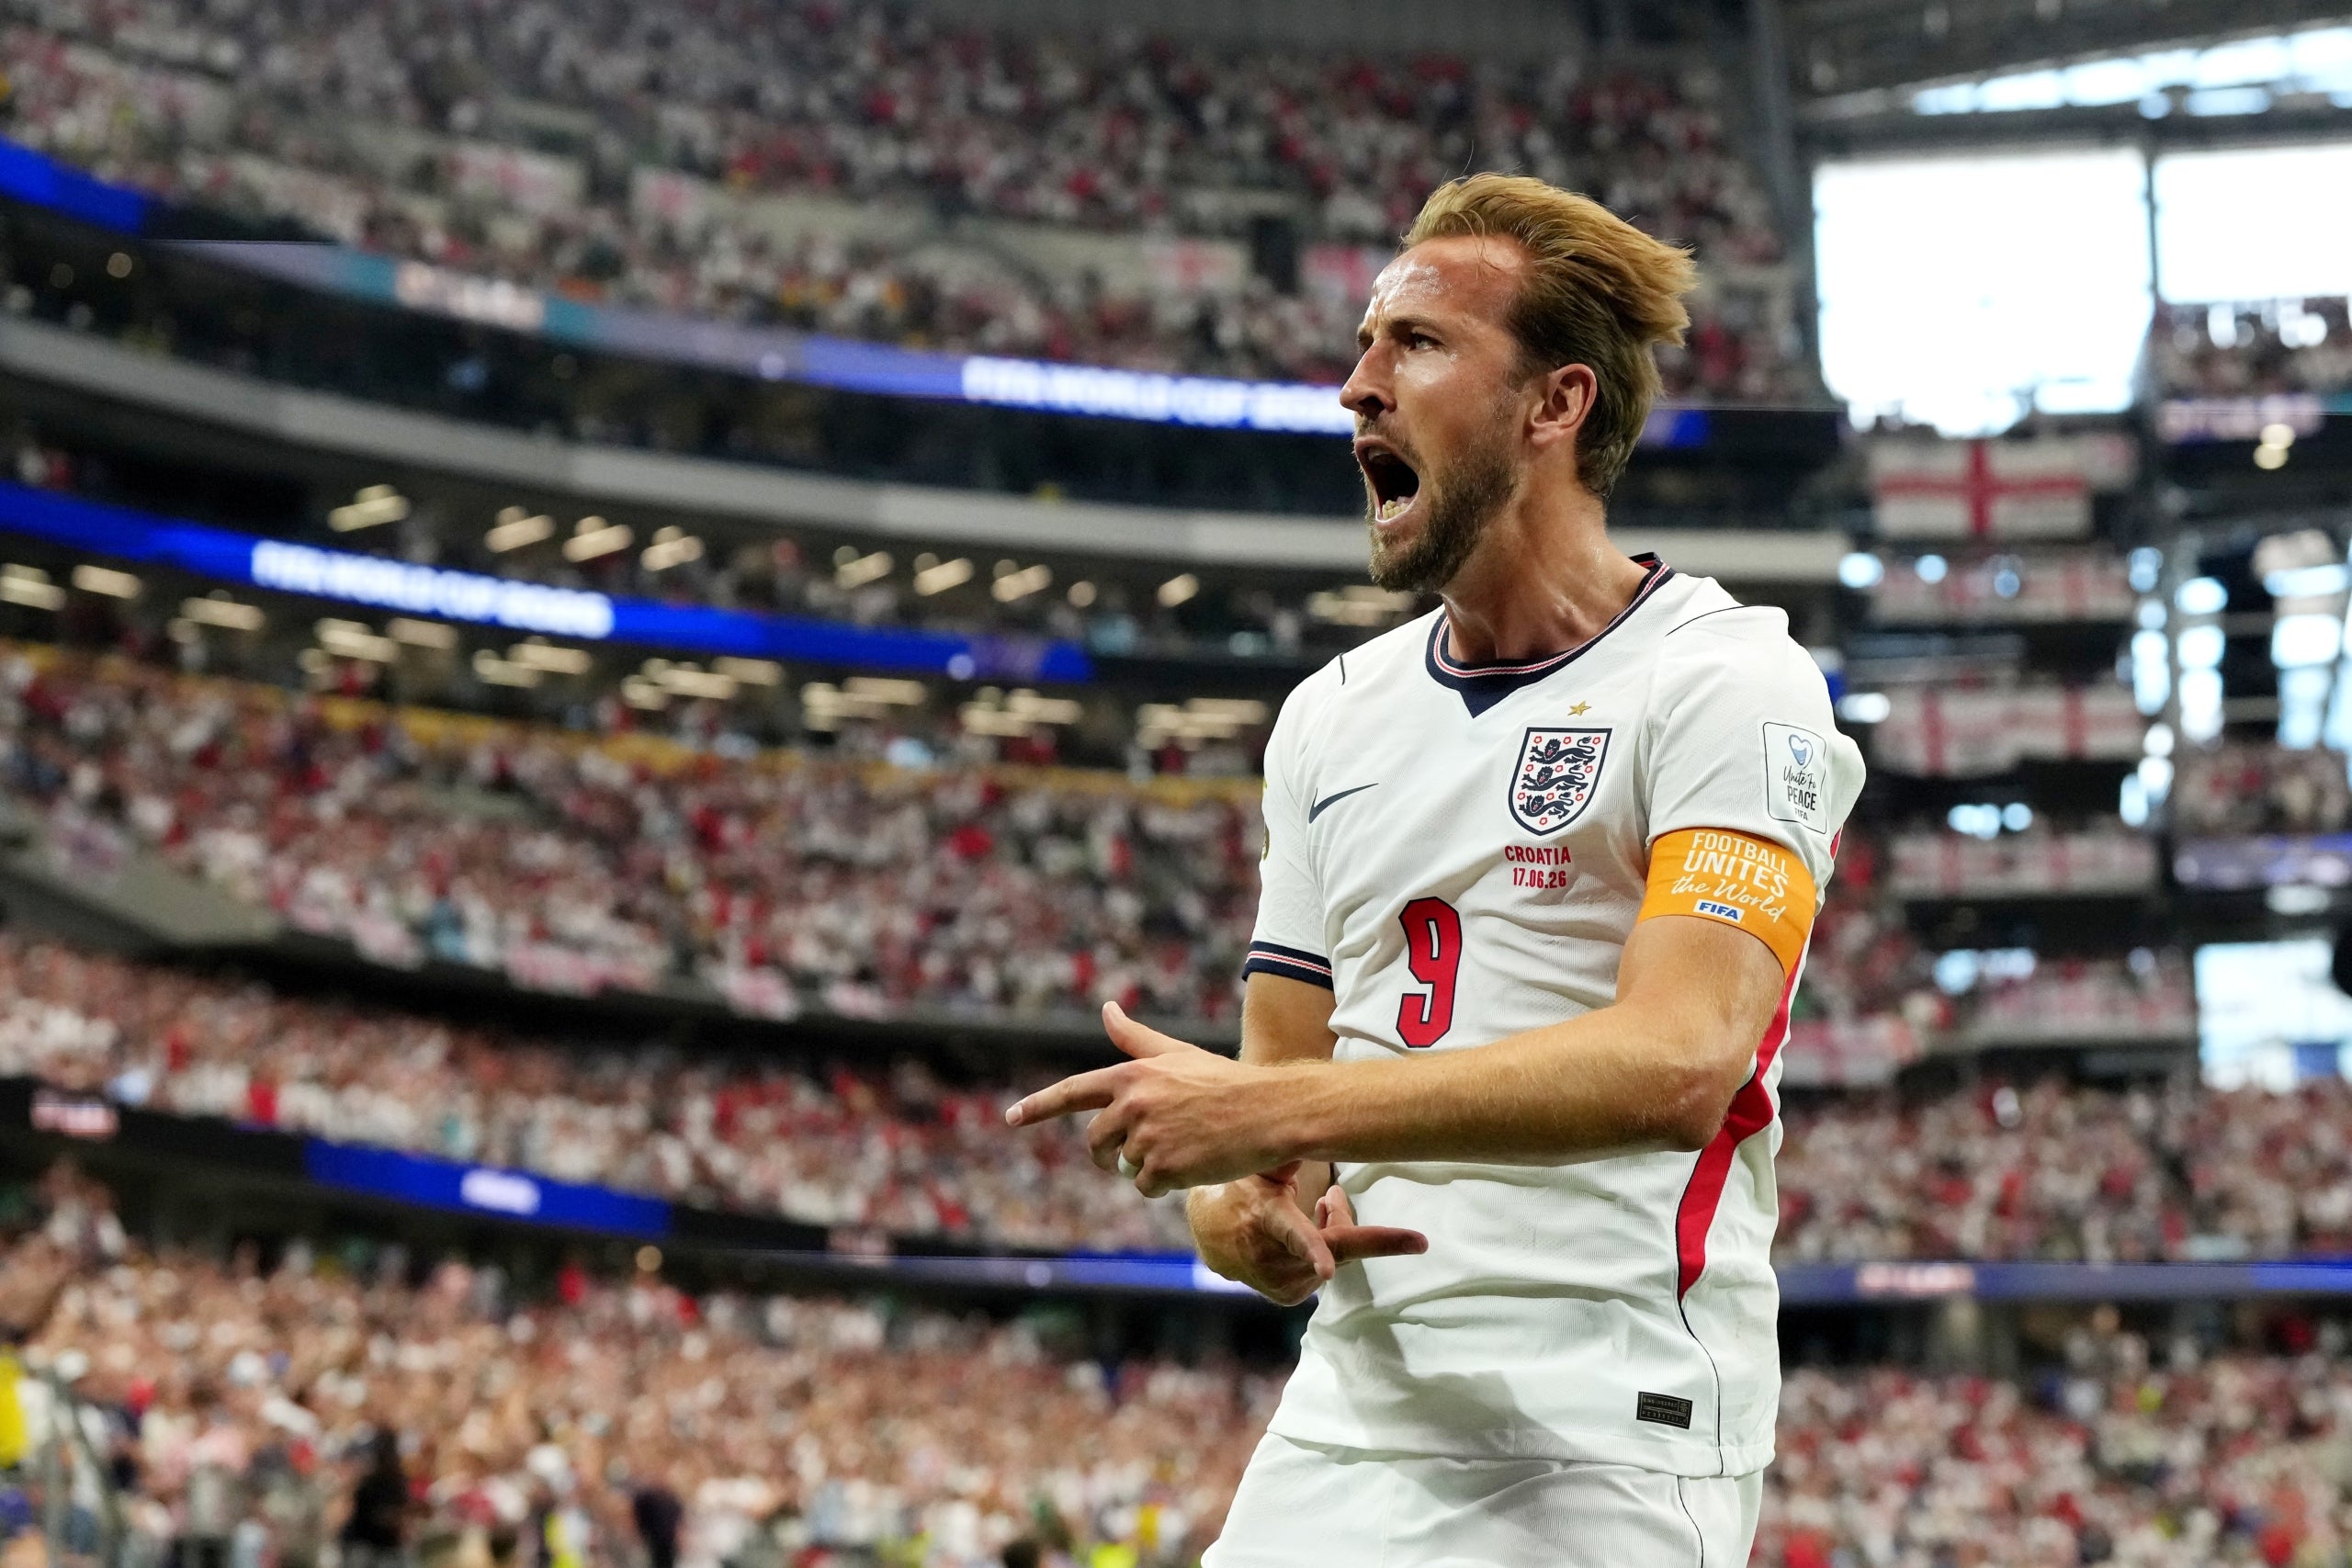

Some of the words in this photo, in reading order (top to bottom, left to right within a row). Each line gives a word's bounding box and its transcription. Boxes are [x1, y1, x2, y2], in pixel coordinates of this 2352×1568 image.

[1783, 765, 1807, 786] Unite
[1787, 784, 1817, 811] PEACE
[1794, 807, 1809, 821] FIFA
[1504, 845, 1572, 865] CROATIA
[1691, 831, 1790, 878] FOOTBALL
[1512, 867, 1567, 889] 17.06.26
[1683, 849, 1789, 898] UNITES
[1671, 874, 1710, 895] the
[1713, 878, 1787, 924] World
[1699, 901, 1739, 920] FIFA
[1396, 896, 1463, 1049] 9
